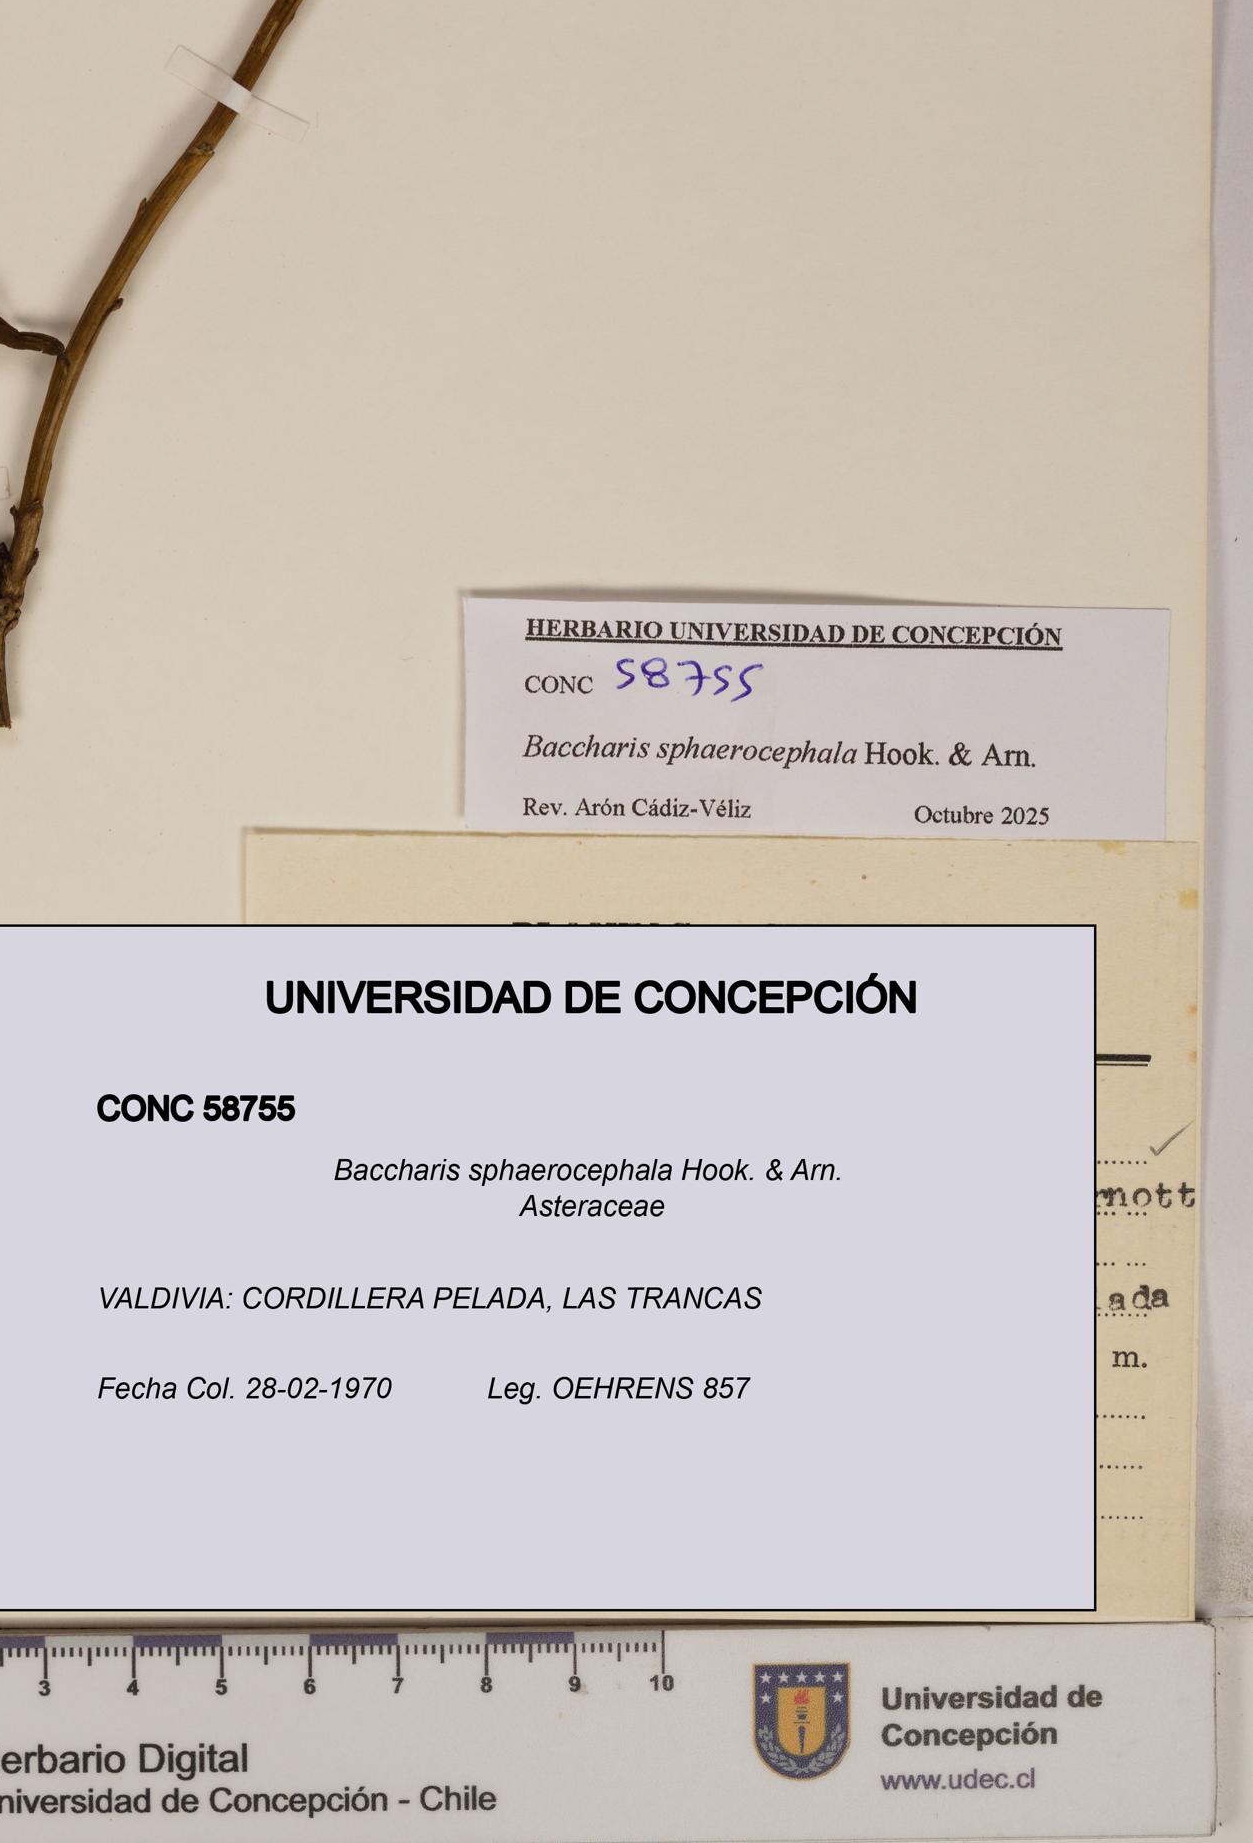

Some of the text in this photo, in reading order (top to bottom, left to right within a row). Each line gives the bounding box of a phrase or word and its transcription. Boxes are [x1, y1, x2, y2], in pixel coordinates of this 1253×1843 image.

[527, 618, 1063, 646] HERBARIO UNIVERSIDAD DE CONCEPCIÓN
[525, 657, 764, 702] CONC 58755
[523, 734, 1036, 769] Baccharis sphaerocephala Hook. & Arn.
[523, 797, 752, 819] Rev. Arón Cádiz-Véliz
[915, 804, 1050, 826] Octubre 2025
[1112, 1350, 1148, 1368] m.
[37, 1679, 52, 1698] 3
[126, 1679, 140, 1697] 4
[214, 1678, 228, 1697] 5
[303, 1677, 317, 1696] 6
[391, 1676, 405, 1695] 7
[479, 1676, 494, 1695] 8
[567, 1675, 582, 1694] 9
[649, 1674, 676, 1693] 10
[881, 1683, 1103, 1710] Universidad de
[881, 1721, 1058, 1751] Concepción
[138, 1742, 248, 1779] Digital
[880, 1767, 1036, 1791] www.udec.cl
[161, 1787, 200, 1814] de
[208, 1785, 389, 1819] Concepción
[419, 1784, 497, 1812] Chile
